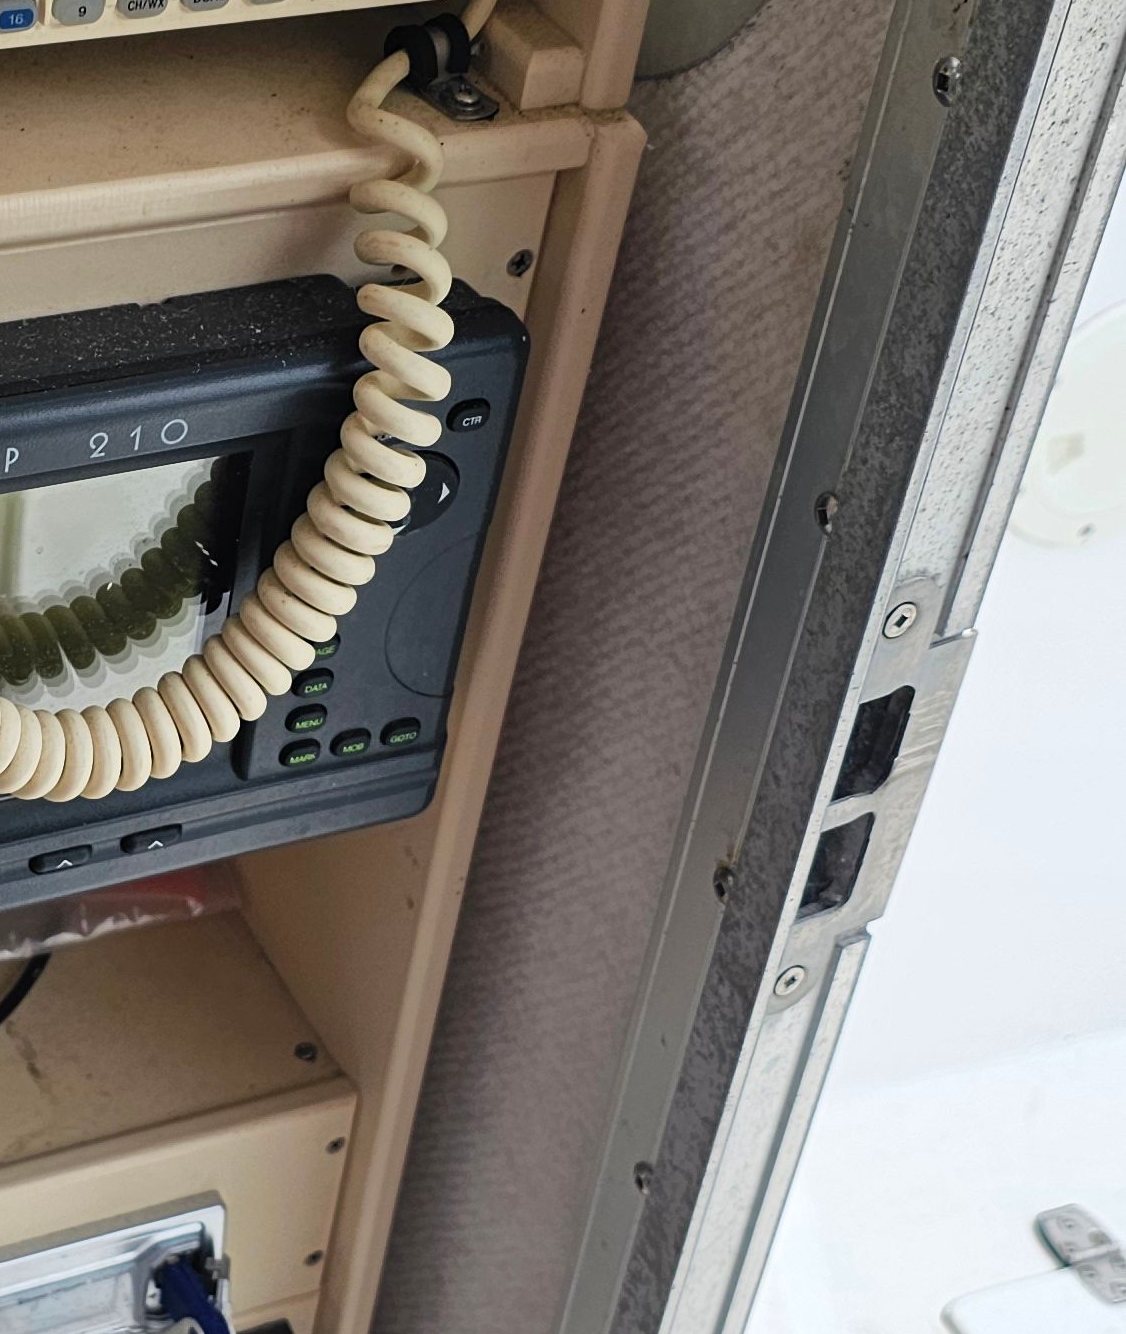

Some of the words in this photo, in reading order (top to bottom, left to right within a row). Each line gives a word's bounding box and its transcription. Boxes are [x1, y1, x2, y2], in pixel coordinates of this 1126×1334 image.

[77, 5, 88, 19] 9
[8, 12, 24, 27] 16
[462, 415, 483, 427] CTR
[88, 418, 189, 459] 210
[315, 644, 336, 656] AGE
[304, 682, 328, 693] DATA
[295, 718, 324, 729] MENU
[389, 731, 417, 743] GOTO
[342, 742, 365, 753] MOB
[289, 752, 316, 764] MARK
